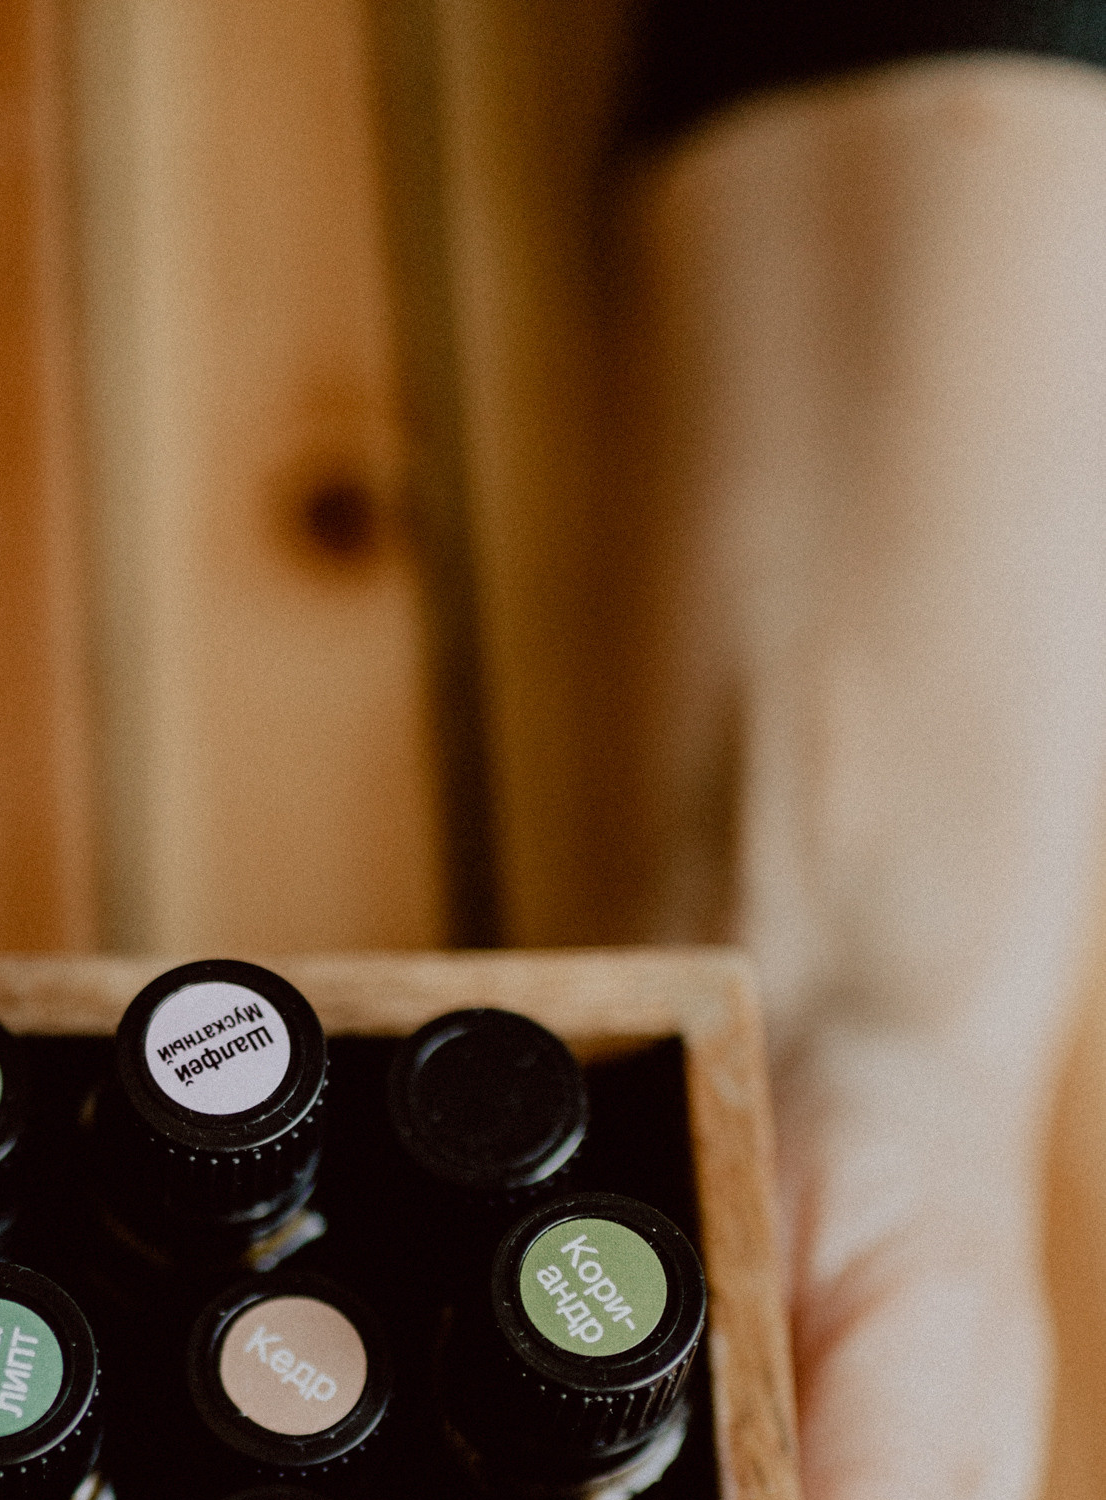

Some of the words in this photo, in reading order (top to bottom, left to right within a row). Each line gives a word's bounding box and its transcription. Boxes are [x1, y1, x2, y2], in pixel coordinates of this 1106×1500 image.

[156, 1002, 265, 1066] Мускатный
[174, 1025, 274, 1087] Шалфей
[536, 1264, 604, 1344] андр
[560, 1233, 636, 1331] Кори-
[244, 1324, 338, 1402] Кедр
